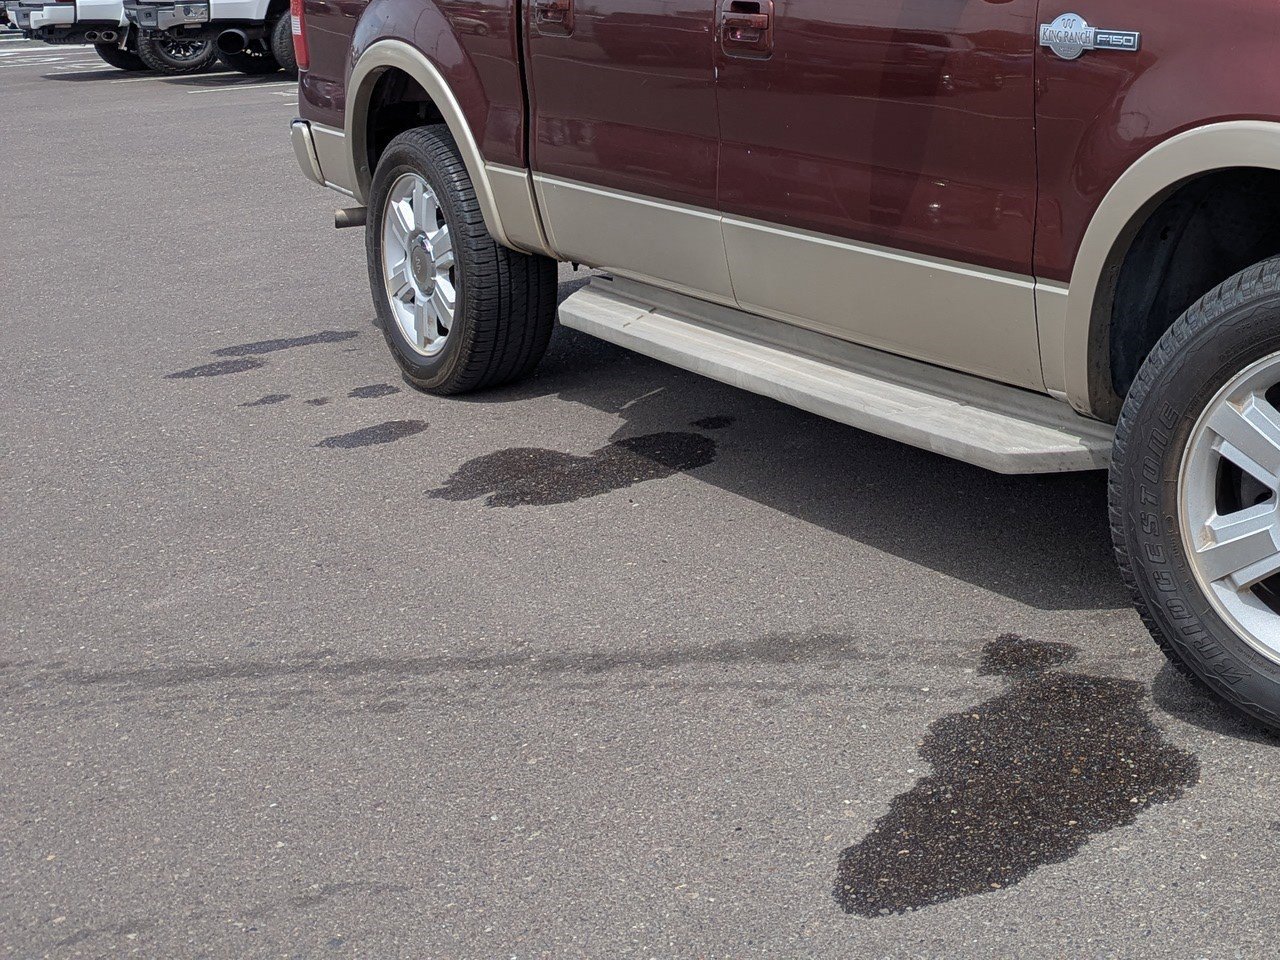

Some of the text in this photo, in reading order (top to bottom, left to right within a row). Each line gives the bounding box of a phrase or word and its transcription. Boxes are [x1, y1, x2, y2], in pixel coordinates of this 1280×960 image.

[1042, 28, 1092, 45] KING RANCH
[1139, 401, 1250, 685] BRIDGESTONE
